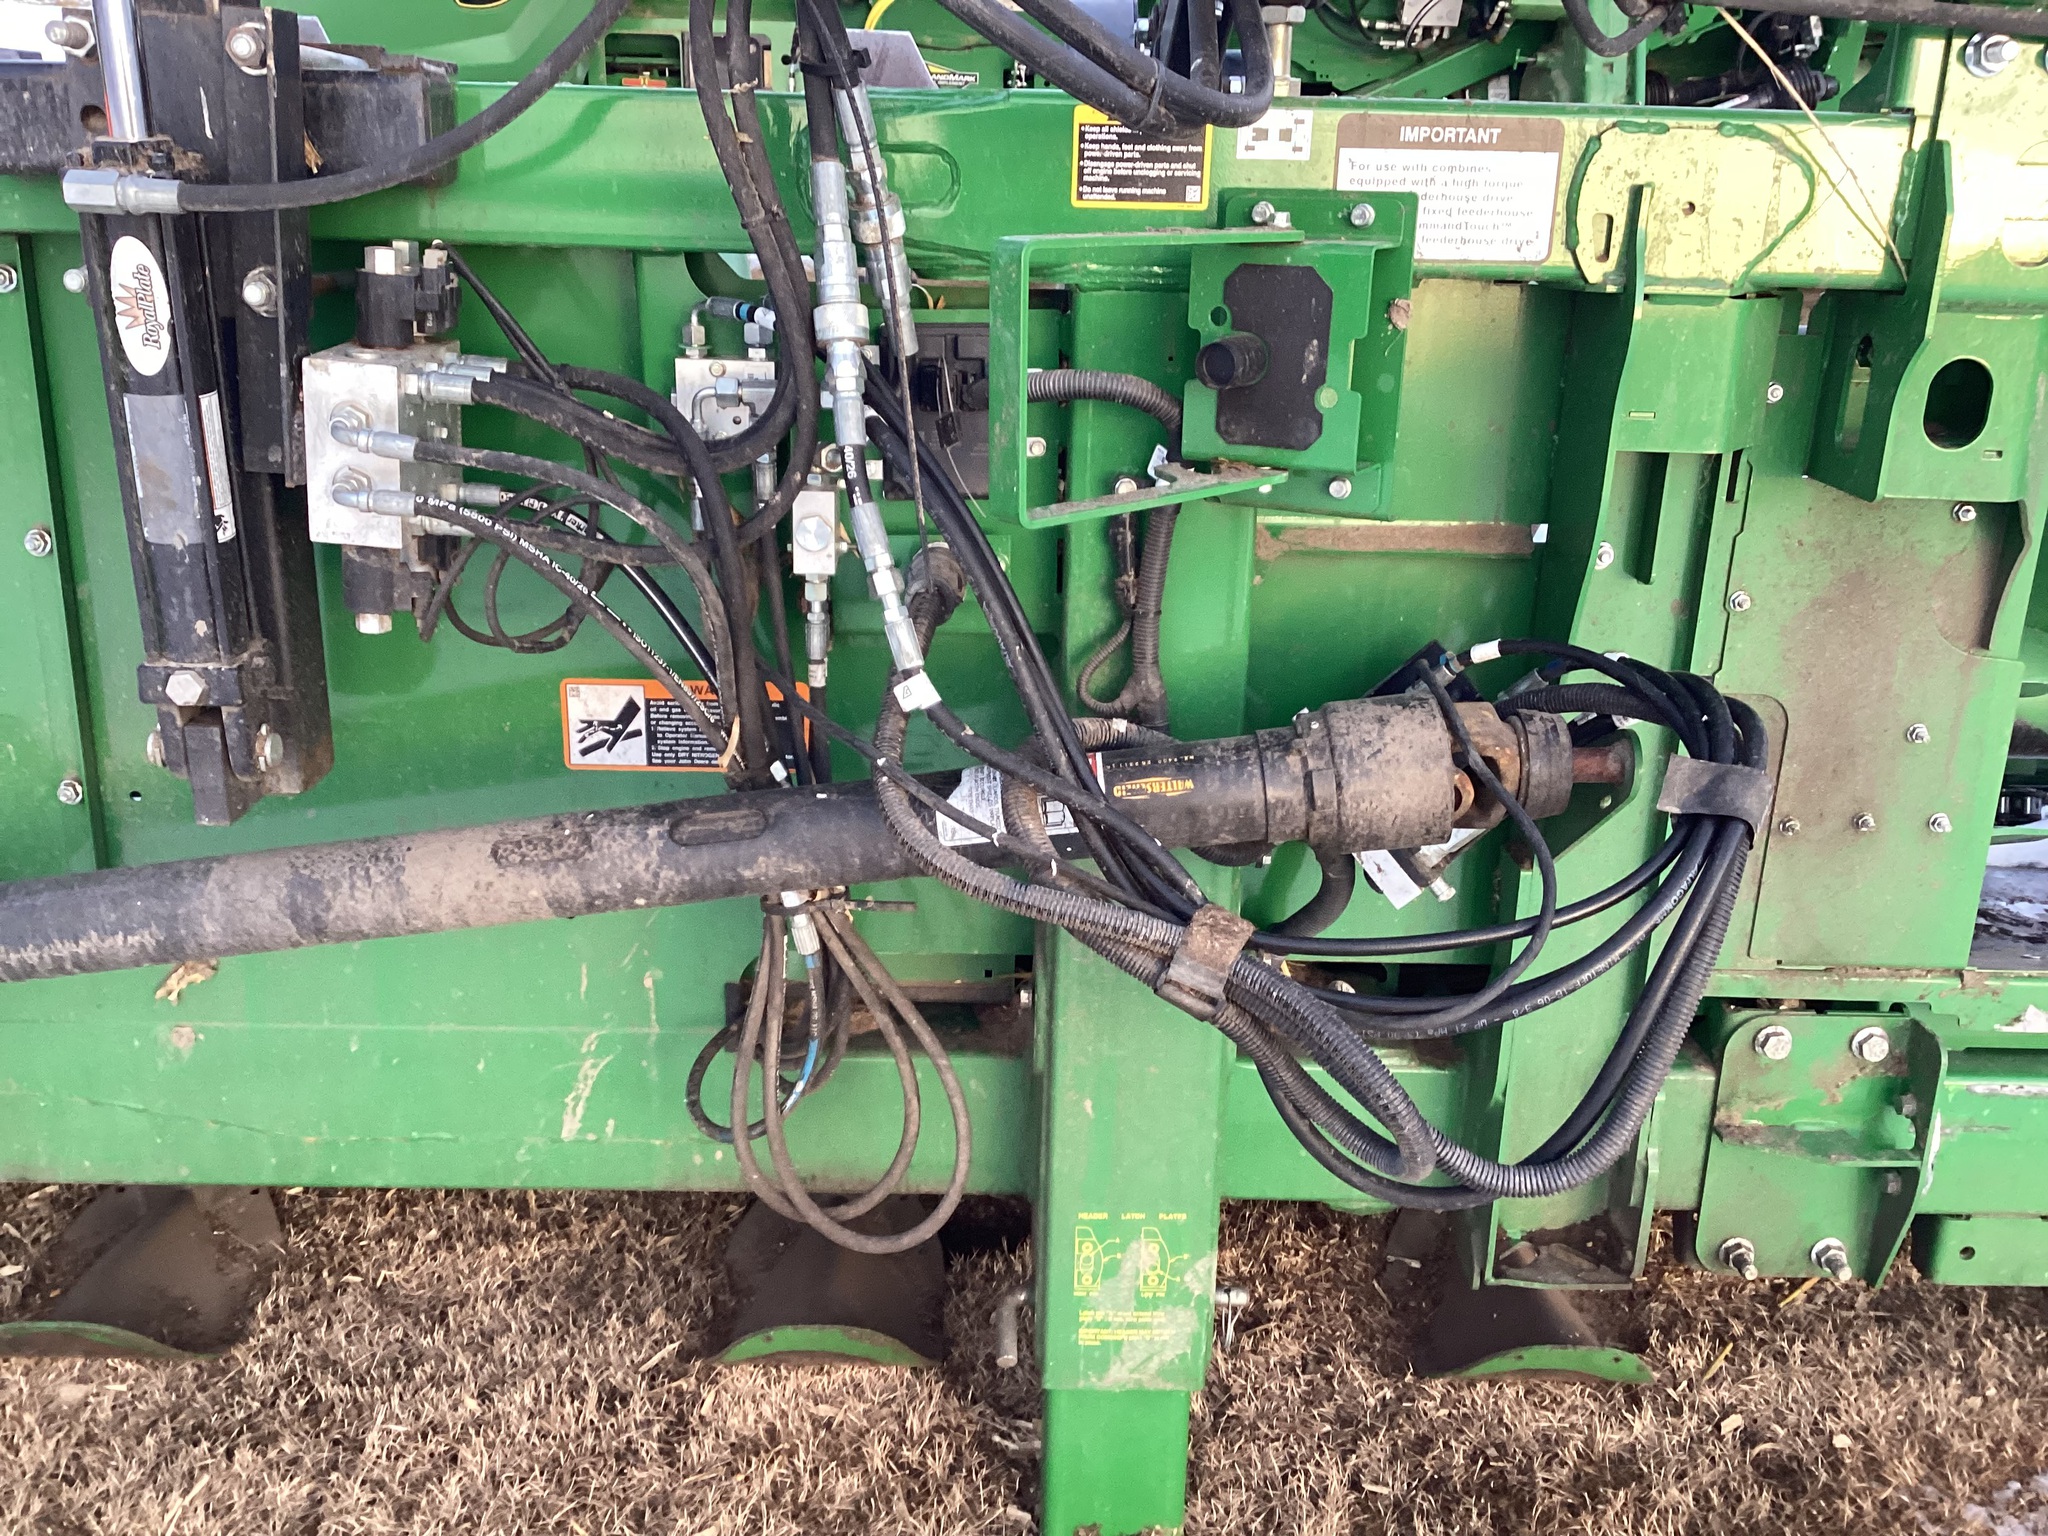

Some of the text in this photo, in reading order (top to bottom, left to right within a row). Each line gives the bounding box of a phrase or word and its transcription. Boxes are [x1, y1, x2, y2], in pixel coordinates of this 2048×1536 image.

[1085, 125, 1100, 133] Keep
[1400, 126, 1501, 144] IMPORTANT
[1085, 142, 1100, 150] Keep
[1147, 144, 1171, 153] clothing
[1154, 162, 1169, 170] parts
[1351, 160, 1370, 171] For
[1376, 163, 1397, 172] use
[1402, 163, 1427, 172] with
[1093, 168, 1112, 176] engine
[1133, 169, 1166, 178] unclogging
[1174, 170, 1201, 178] servicing
[1349, 176, 1406, 187] equipped
[1411, 176, 1436, 187] with
[1452, 178, 1479, 189] high
[1119, 187, 1141, 195] running
[1483, 193, 1513, 202] drive
[1422, 206, 1533, 217] fixed feederhouse
[1422, 236, 1496, 245] feederhouse
[132, 264, 162, 351] RoyalPlate
[427, 496, 456, 512] MPa
[493, 522, 518, 544] PSI)
[518, 538, 551, 565] MSHA
[1512, 1003, 1533, 1018] 3/8
[1078, 1212, 1108, 1220] HEADER
